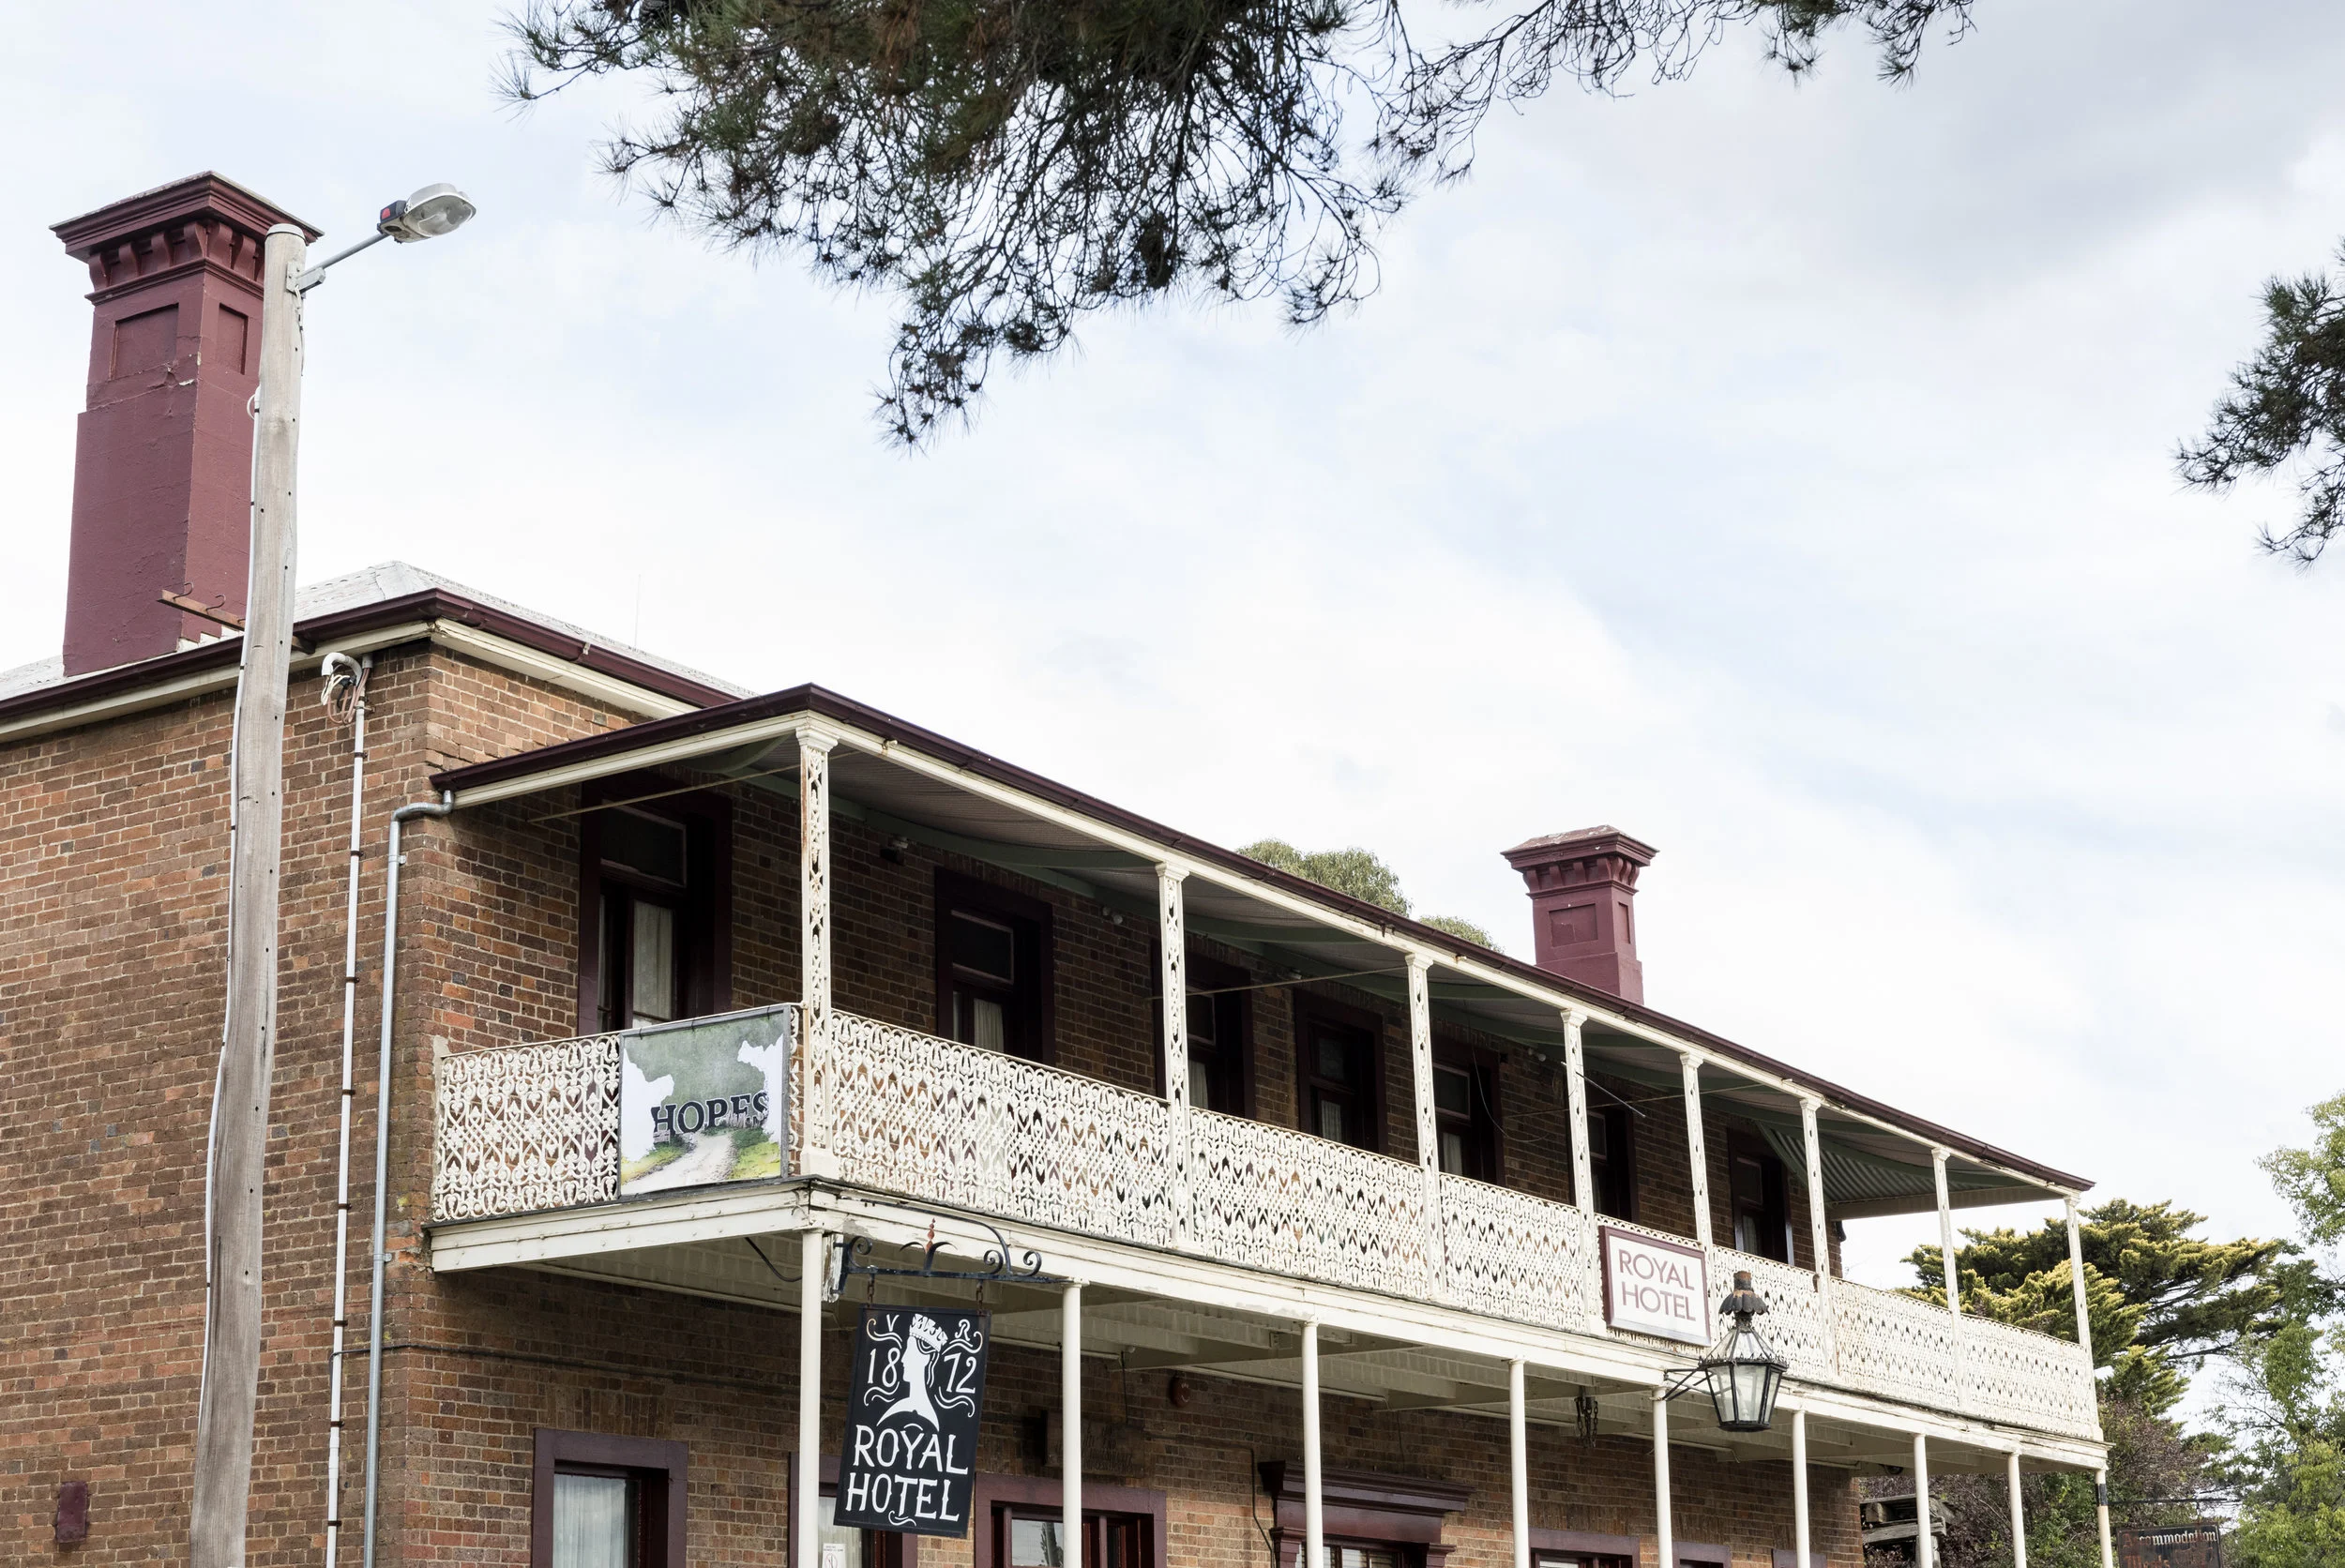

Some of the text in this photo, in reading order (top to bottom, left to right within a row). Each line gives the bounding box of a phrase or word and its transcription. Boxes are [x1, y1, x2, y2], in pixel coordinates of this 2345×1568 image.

[1618, 1248, 1696, 1291] ROYAL
[1621, 1281, 1697, 1322] HOTEL
[852, 1424, 969, 1475] ROYAL
[844, 1471, 961, 1522] HOTEL
